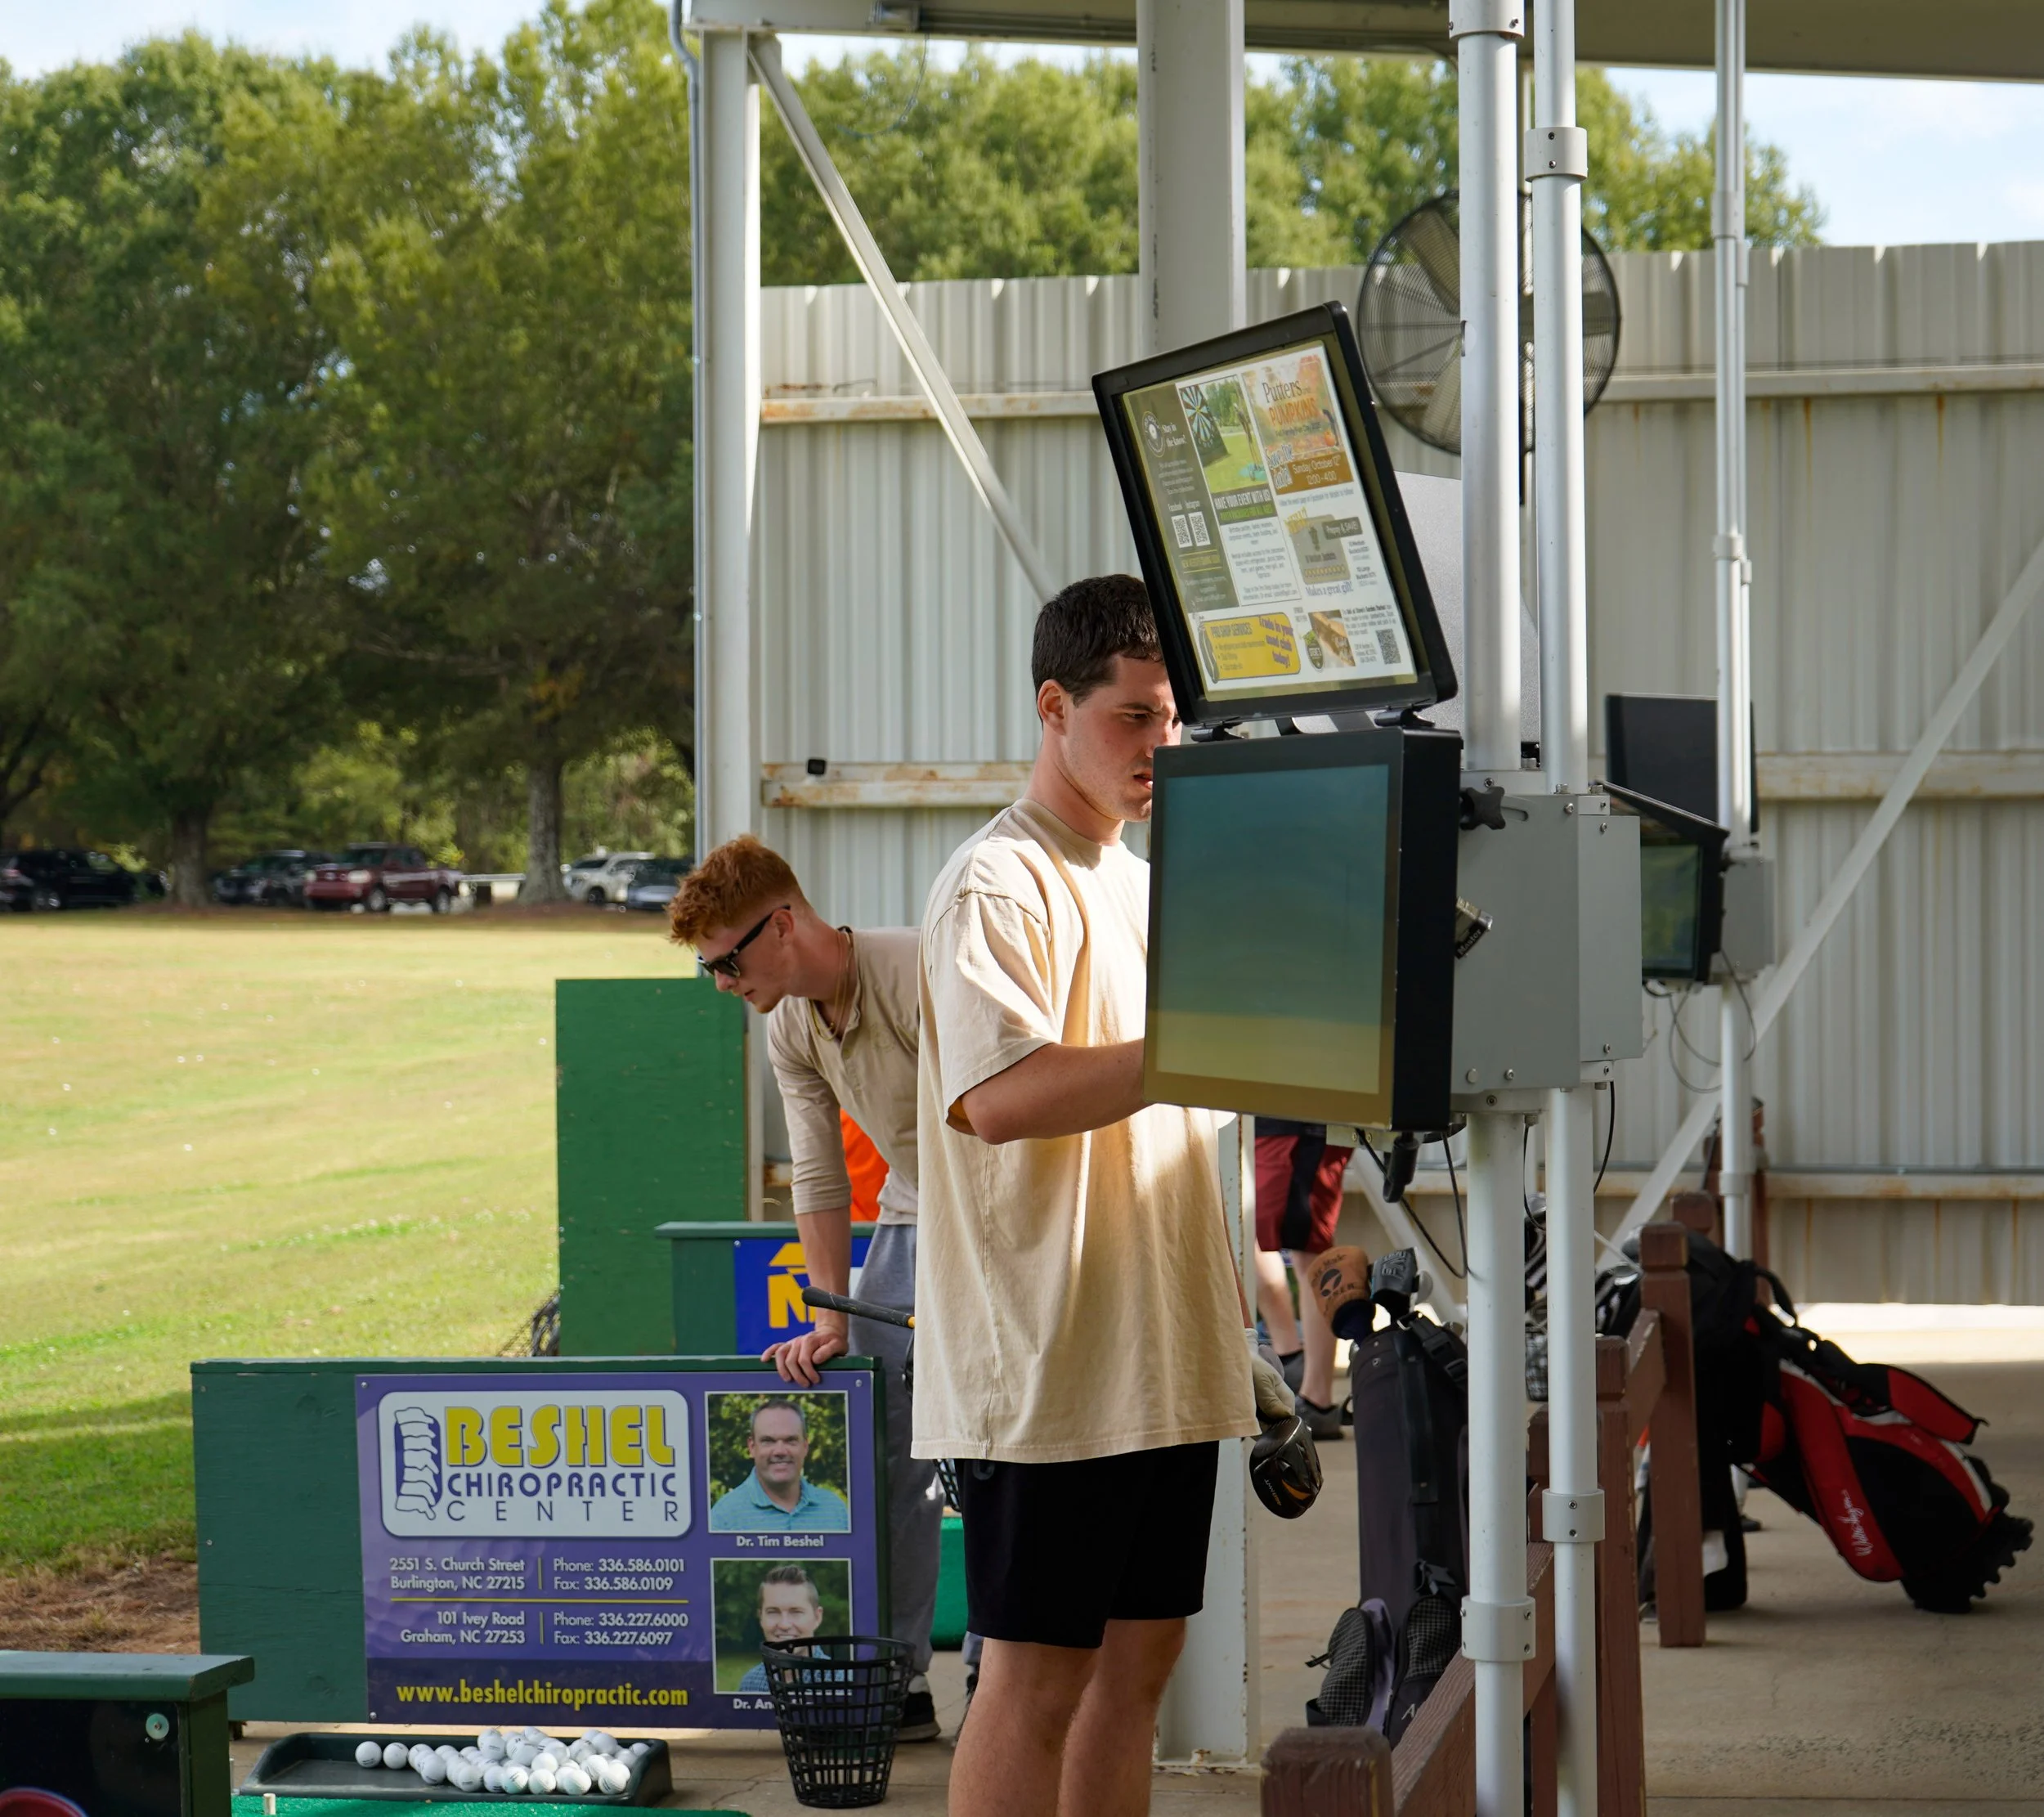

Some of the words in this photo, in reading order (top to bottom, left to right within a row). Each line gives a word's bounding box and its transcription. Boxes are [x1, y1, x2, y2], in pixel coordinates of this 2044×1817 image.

[1262, 379, 1302, 402] Putters
[1269, 397, 1317, 426] PUMPKINS
[1311, 458, 1332, 469] October
[1214, 497, 1228, 509] HAVE
[1238, 493, 1252, 505] EVENT
[1306, 585, 1322, 596] Makes
[1326, 585, 1341, 595] great
[445, 1404, 675, 1469] BESHEL
[447, 1472, 677, 1497] CHIROPRACTIC
[446, 1500, 679, 1522] CENTER
[736, 1535, 755, 1547] Dr.
[757, 1534, 780, 1547] Tim
[783, 1534, 824, 1547] Beshel
[389, 1557, 420, 1572] 2551
[424, 1557, 437, 1572] S.
[441, 1556, 485, 1572] Church
[488, 1557, 525, 1572] Street
[553, 1557, 594, 1572] Phone:
[598, 1558, 685, 1572] 336.586.0101
[390, 1574, 459, 1593] Burlington,
[462, 1575, 483, 1590] NC
[486, 1576, 526, 1590] 27215
[554, 1577, 580, 1590] Fax:
[584, 1577, 674, 1591] 336.586.0109
[436, 1611, 458, 1625] 101
[462, 1611, 489, 1629] Ivey
[491, 1610, 526, 1626] Road
[553, 1611, 594, 1626] Phone:
[598, 1612, 689, 1627] 336.227.6000
[400, 1627, 457, 1645] Graham,
[459, 1629, 481, 1644] NC
[484, 1630, 526, 1644] 27253
[554, 1631, 580, 1644] Fax:
[584, 1631, 674, 1645] 336.227.6097
[396, 1679, 688, 1711] www.beshelchiropractic.com
[733, 1698, 751, 1710] Dr.
